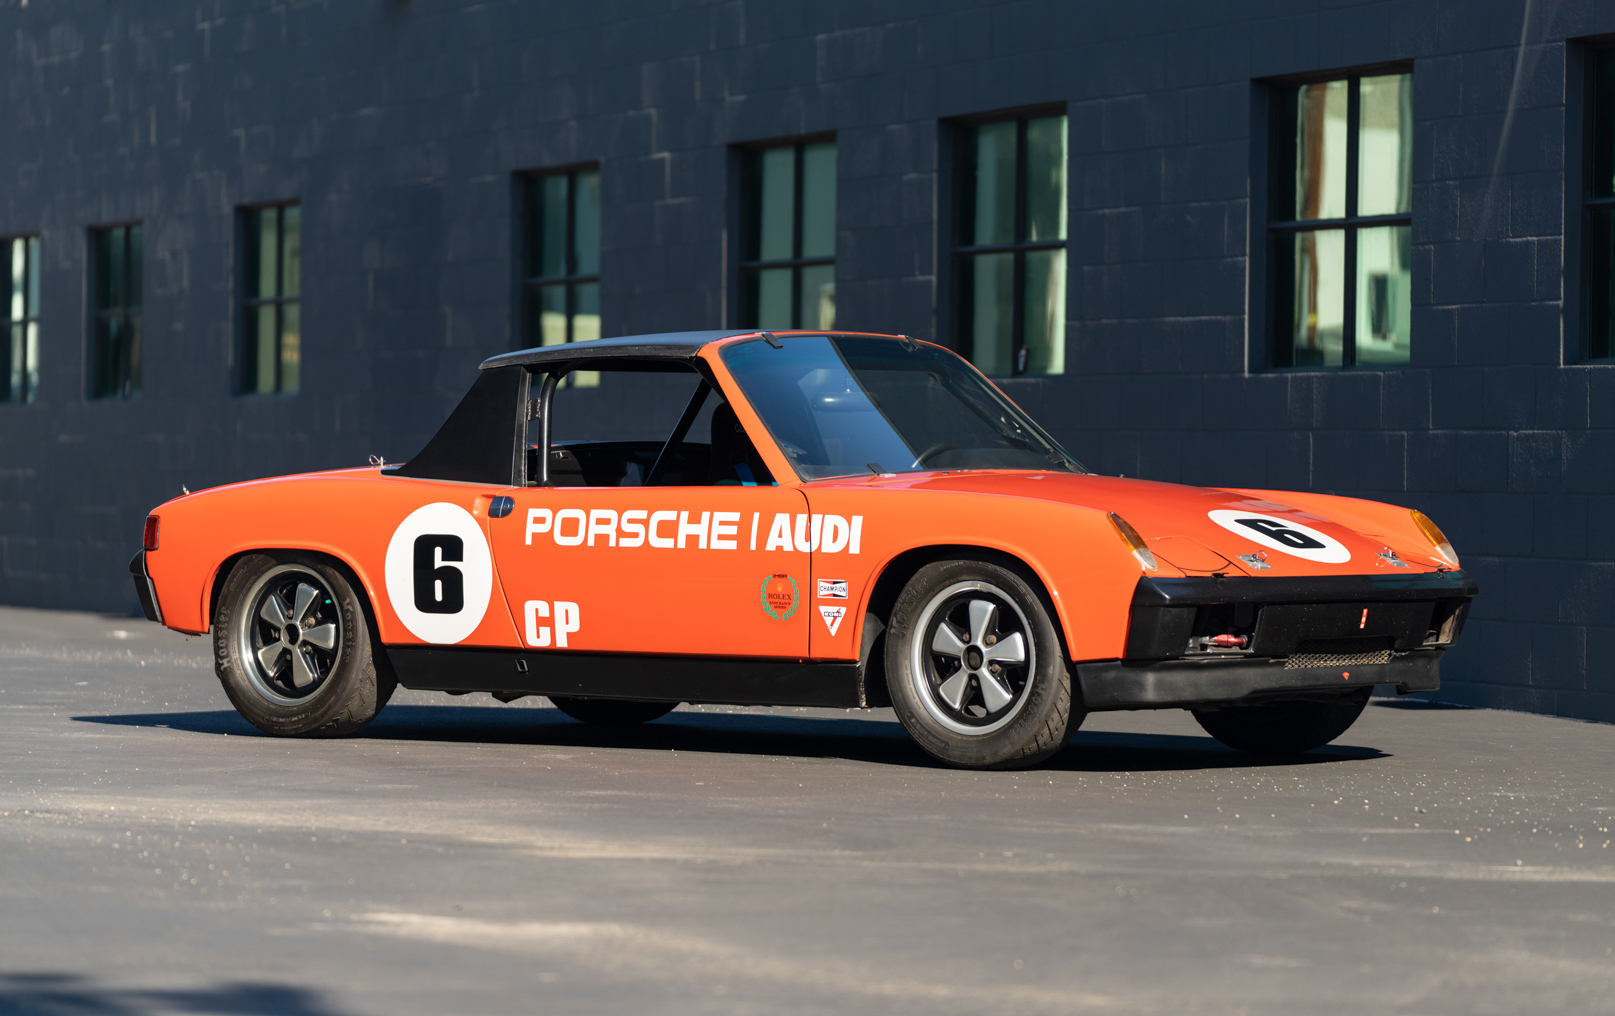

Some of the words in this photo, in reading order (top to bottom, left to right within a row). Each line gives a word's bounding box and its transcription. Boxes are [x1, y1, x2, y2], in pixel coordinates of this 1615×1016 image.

[525, 508, 740, 549] PORSCHE
[765, 513, 863, 554] AUDI
[1234, 519, 1325, 548] 6
[414, 534, 464, 614] 6
[768, 593, 792, 601] ROLEX
[820, 585, 846, 593] CHAMPION
[217, 606, 233, 672] Hoosier
[525, 600, 580, 647] CP
